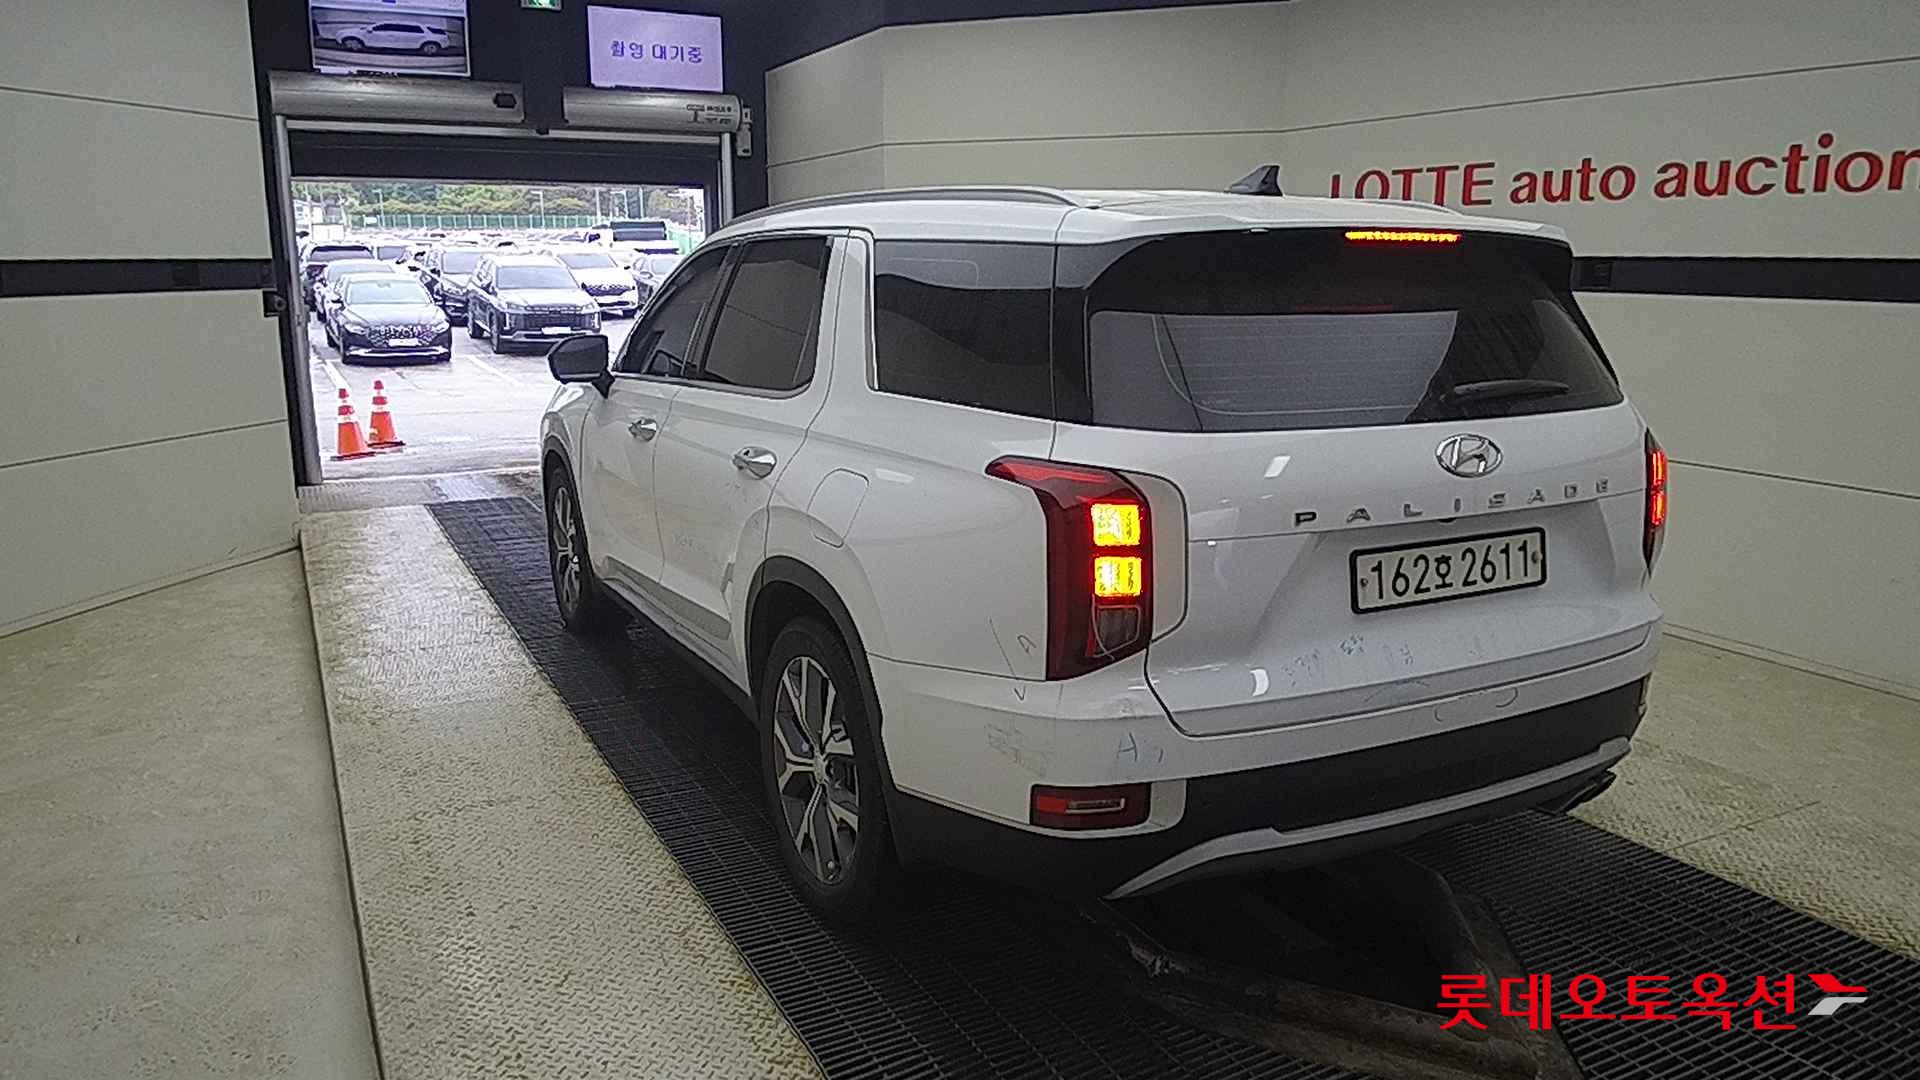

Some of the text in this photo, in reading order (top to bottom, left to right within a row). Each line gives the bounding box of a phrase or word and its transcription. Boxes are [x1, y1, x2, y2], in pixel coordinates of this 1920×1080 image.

[610, 40, 704, 64] 촬영 대기중
[1510, 157, 1636, 204] auto
[1294, 478, 1611, 527] PALISADE
